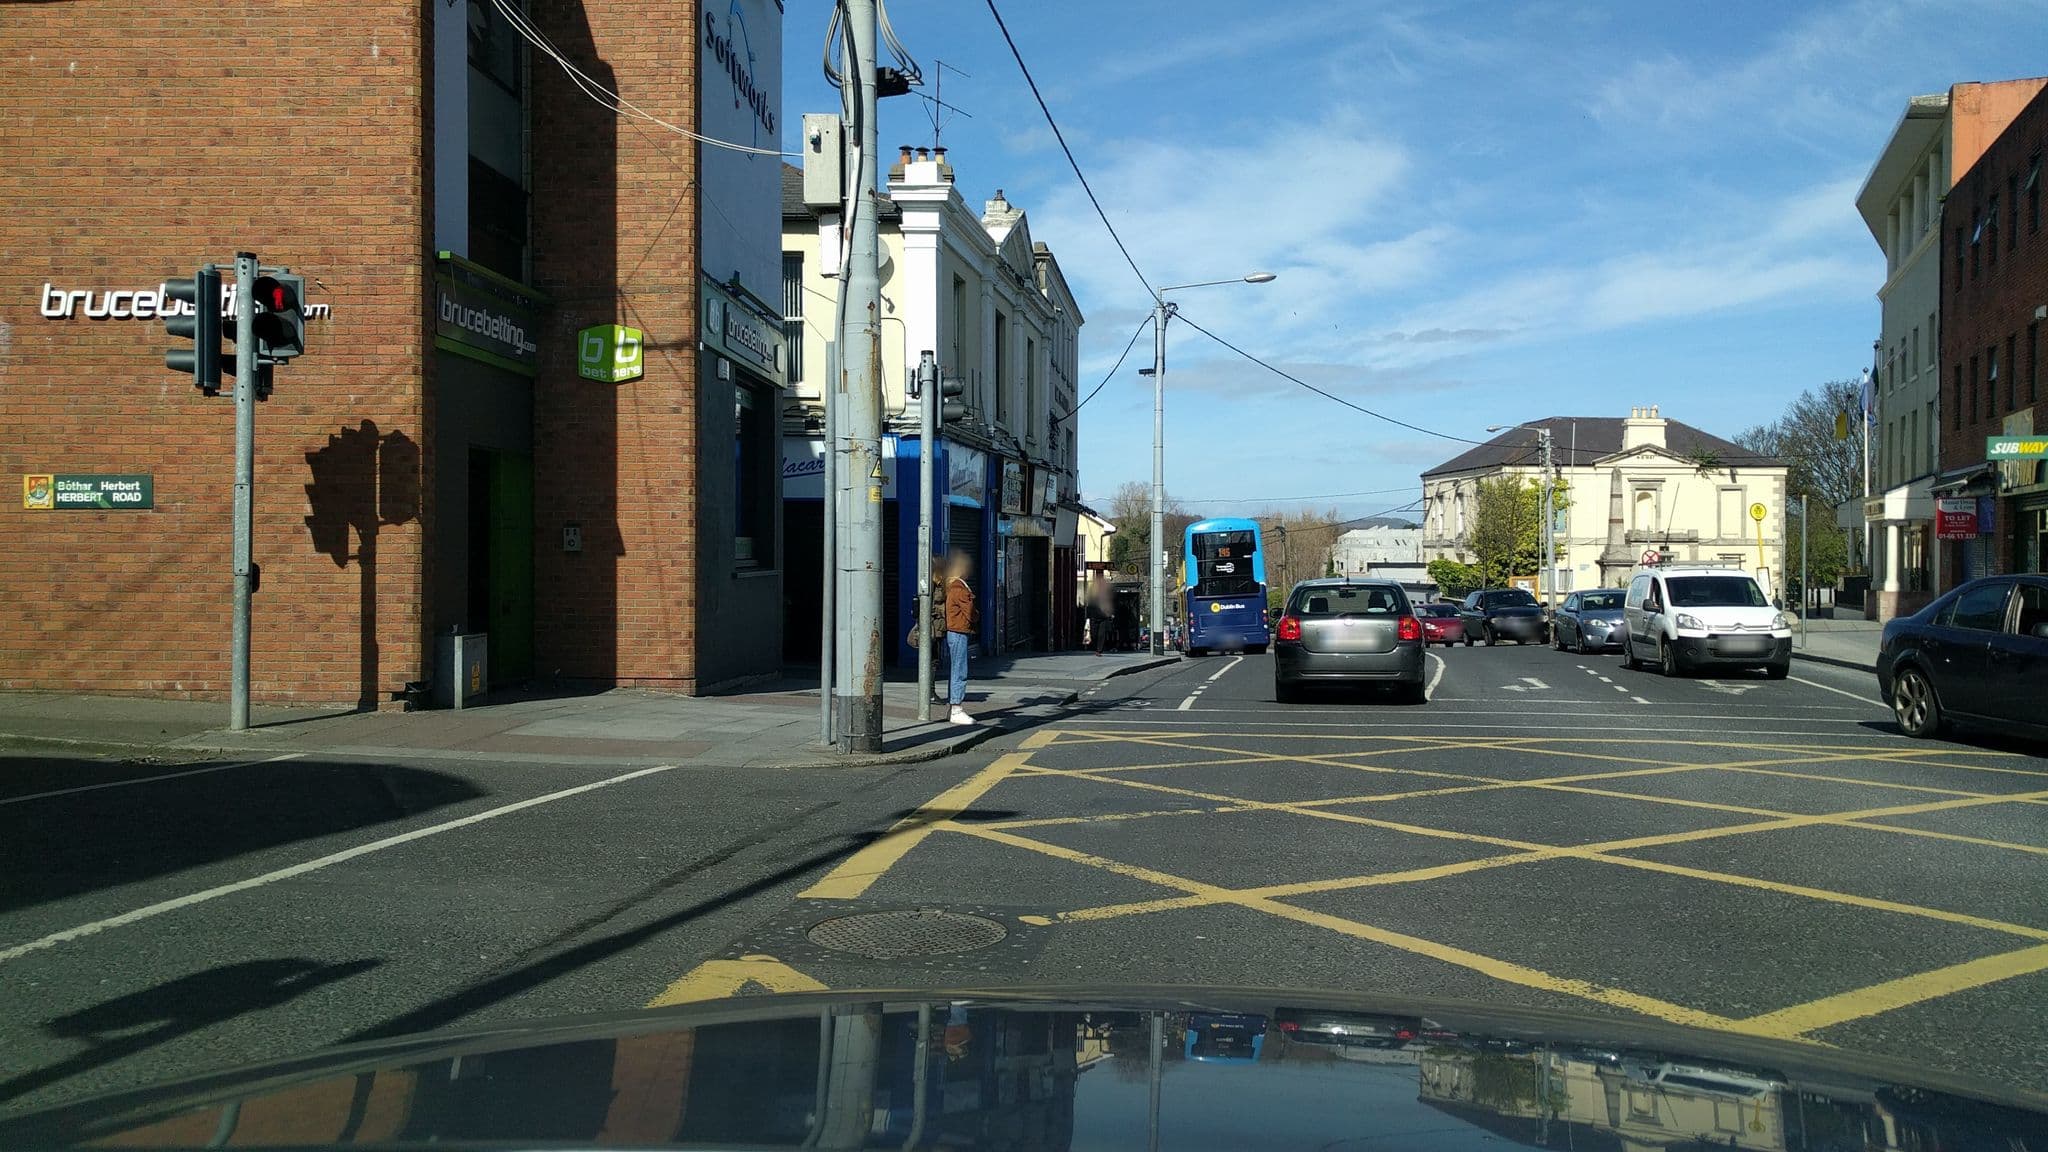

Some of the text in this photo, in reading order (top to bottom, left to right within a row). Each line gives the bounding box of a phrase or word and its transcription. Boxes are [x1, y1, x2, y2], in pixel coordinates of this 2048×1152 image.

[440, 292, 537, 355] brucebetting.com
[582, 364, 641, 379] bet here
[1990, 441, 2048, 454] SUBWAY
[57, 480, 140, 491] Bóthar Herbert
[57, 493, 142, 502] HERBERT ROAD
